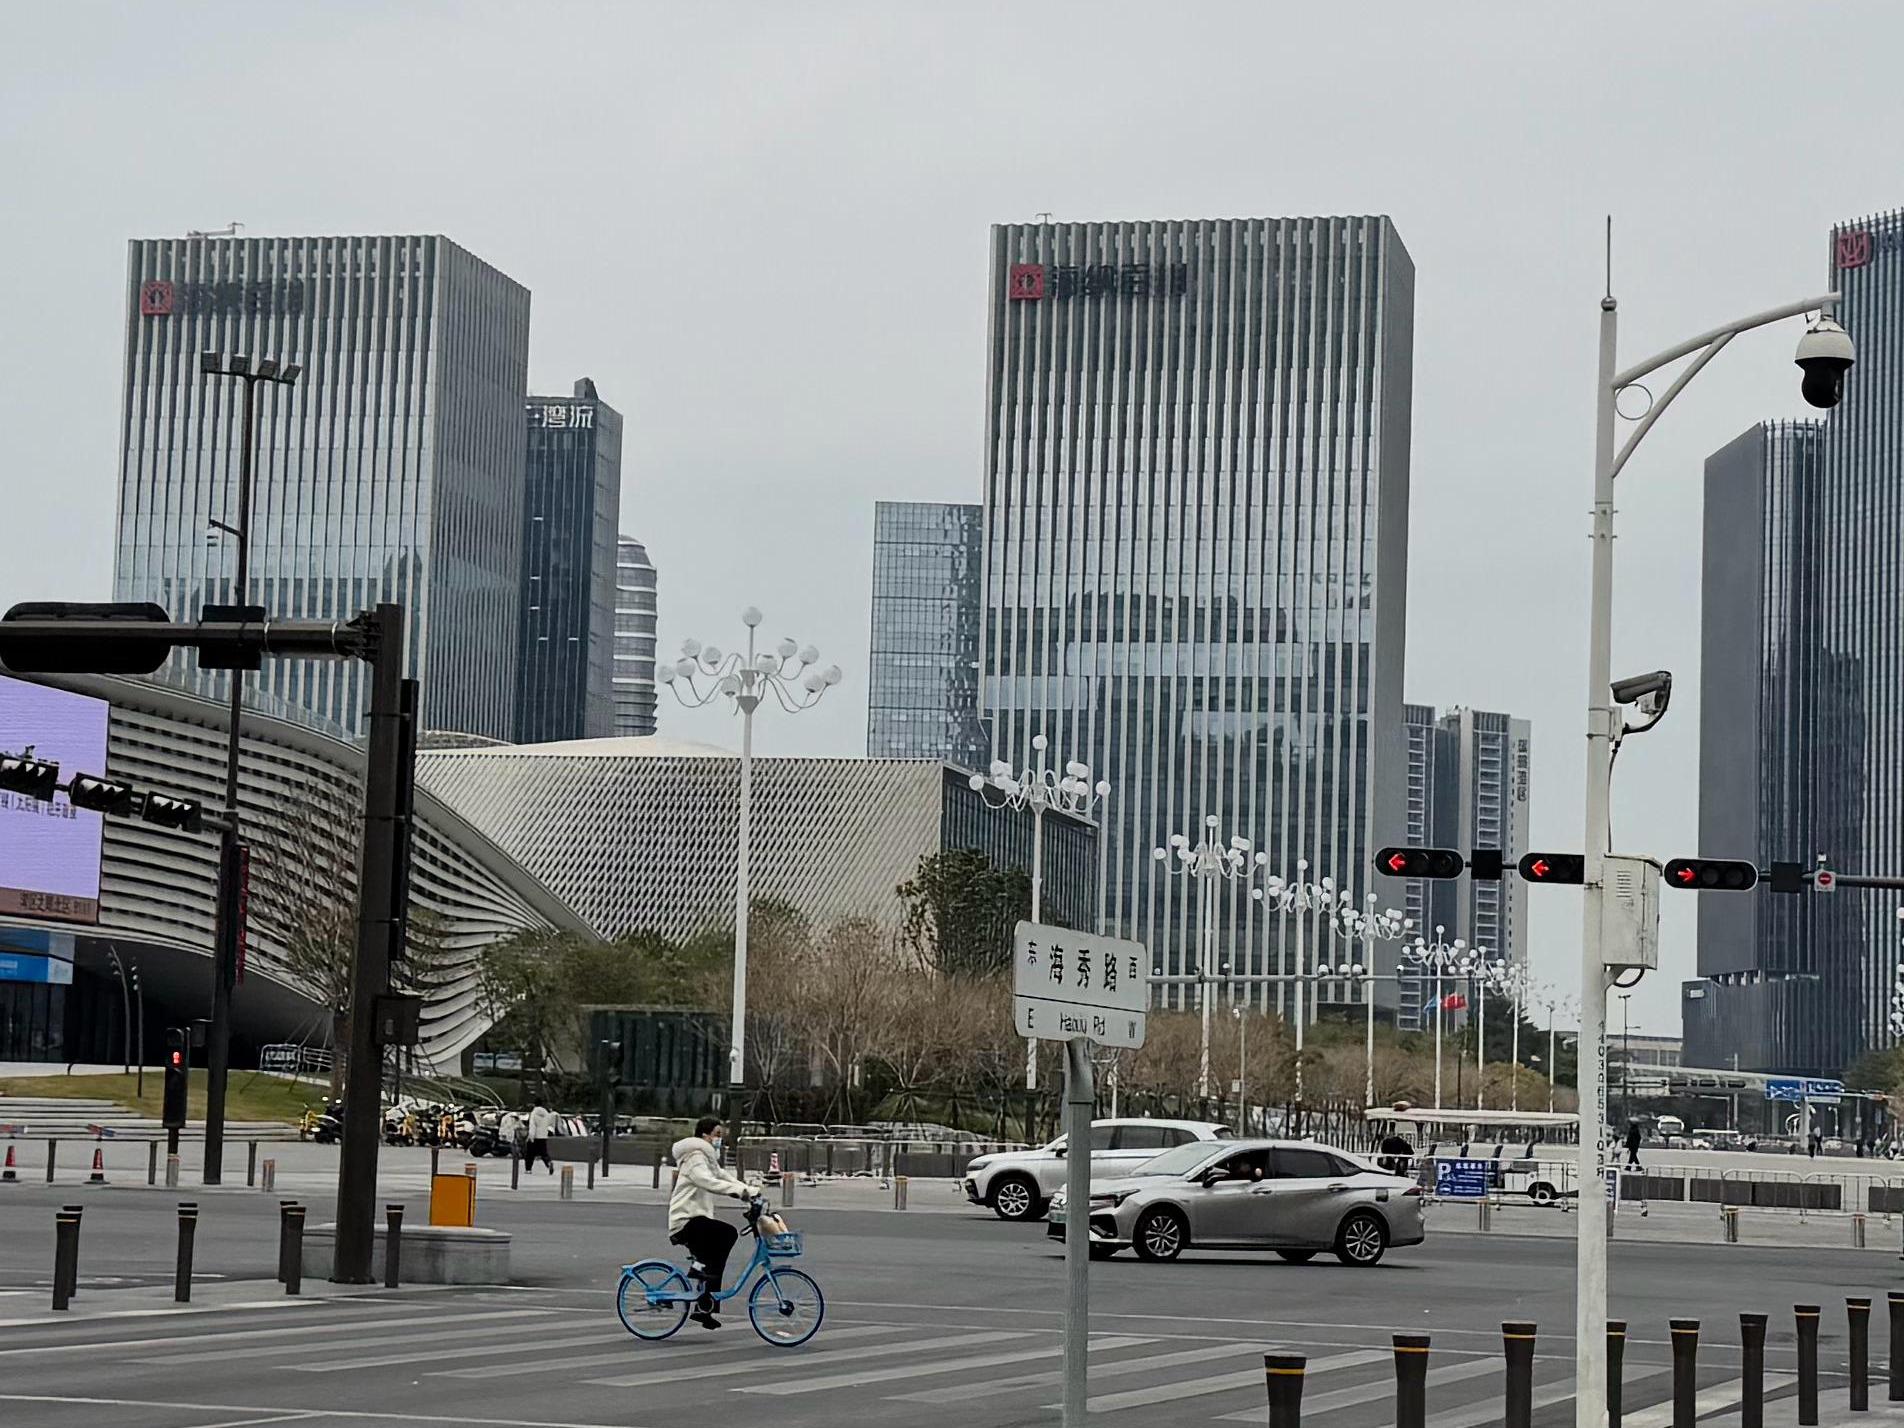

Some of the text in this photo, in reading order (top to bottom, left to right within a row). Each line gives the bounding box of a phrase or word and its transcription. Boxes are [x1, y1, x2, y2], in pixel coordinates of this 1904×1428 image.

[1049, 943, 1118, 993] 海秀路
[1027, 1008, 1035, 1029] E
[1093, 1015, 1106, 1037] Rd
[1438, 1162, 1451, 1180] P
